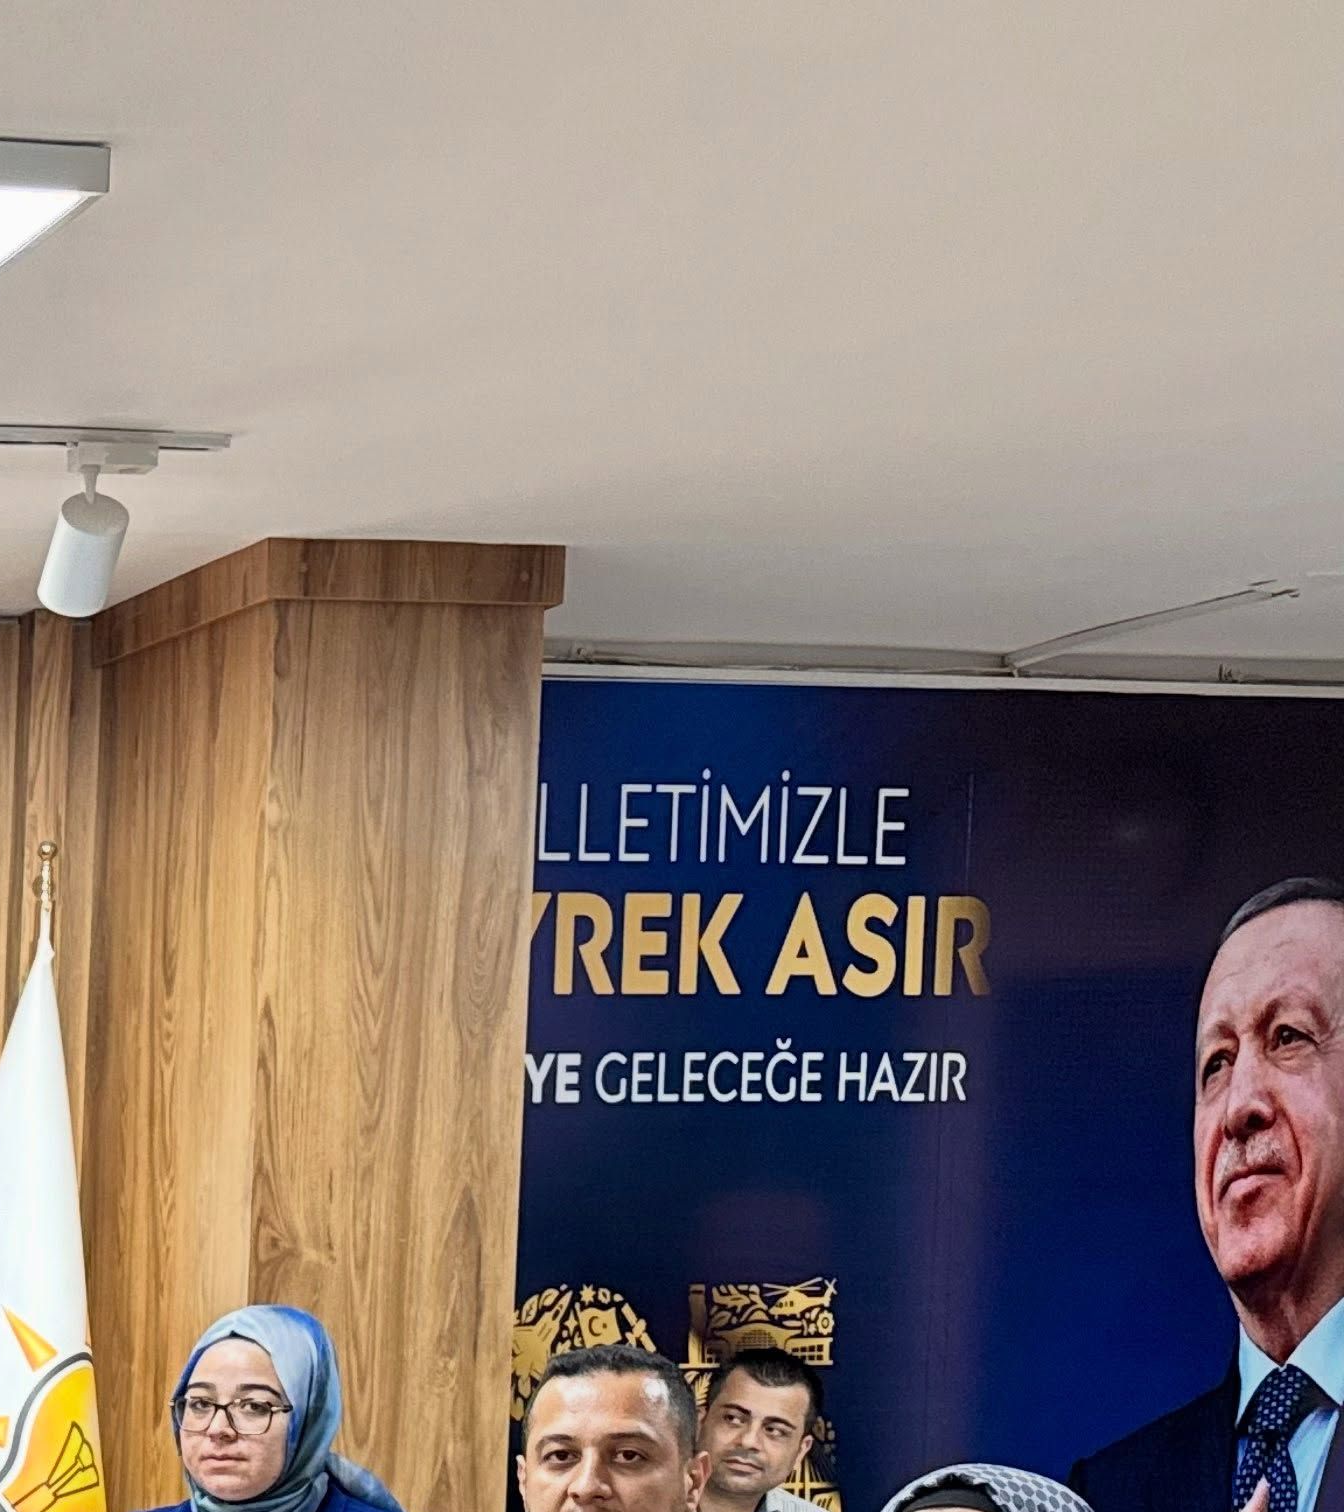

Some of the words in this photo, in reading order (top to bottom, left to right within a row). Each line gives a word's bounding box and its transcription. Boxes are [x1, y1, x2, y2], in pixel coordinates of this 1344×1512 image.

[538, 767, 910, 866] LLETİMİZLE
[765, 891, 993, 998] ASIR
[524, 1052, 582, 1104] YE
[594, 1037, 825, 1103] GELECEĞE
[837, 1052, 969, 1103] HAZIR
